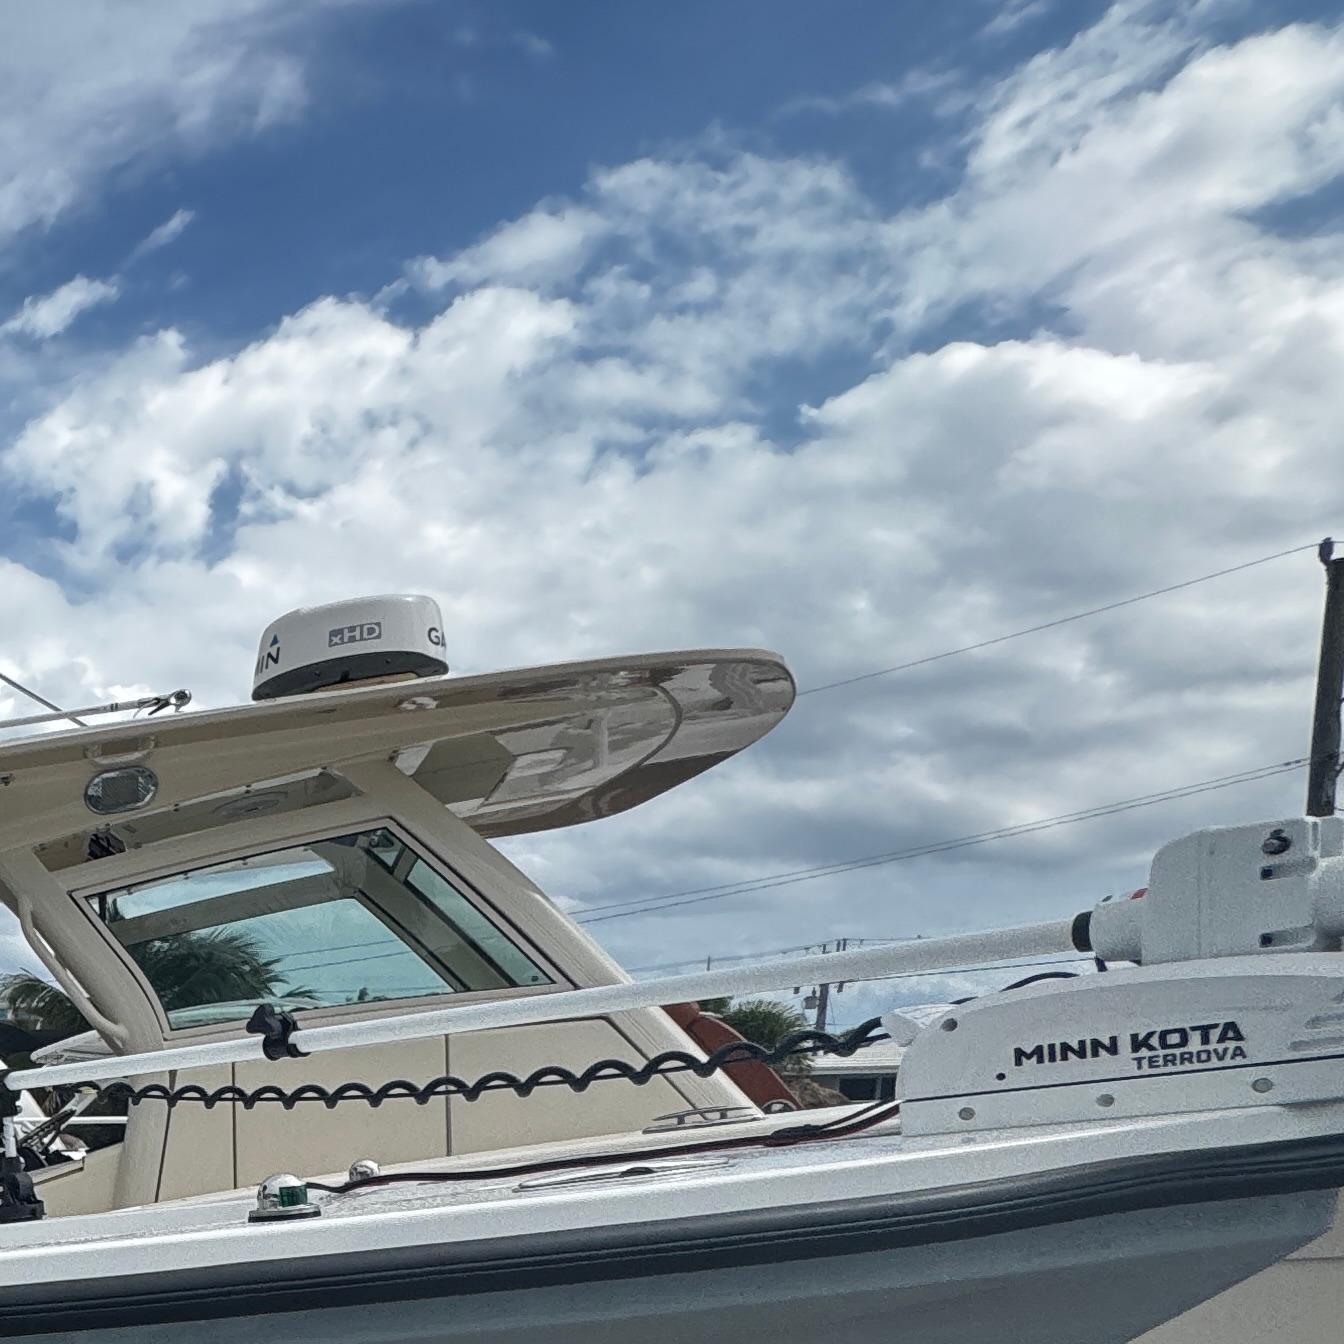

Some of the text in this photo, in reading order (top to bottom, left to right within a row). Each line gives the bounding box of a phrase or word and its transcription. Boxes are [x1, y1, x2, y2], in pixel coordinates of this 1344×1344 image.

[330, 623, 380, 645] xHD
[1014, 1021, 1246, 1067] MINN KOTA
[1132, 1046, 1248, 1071] TERROVA
